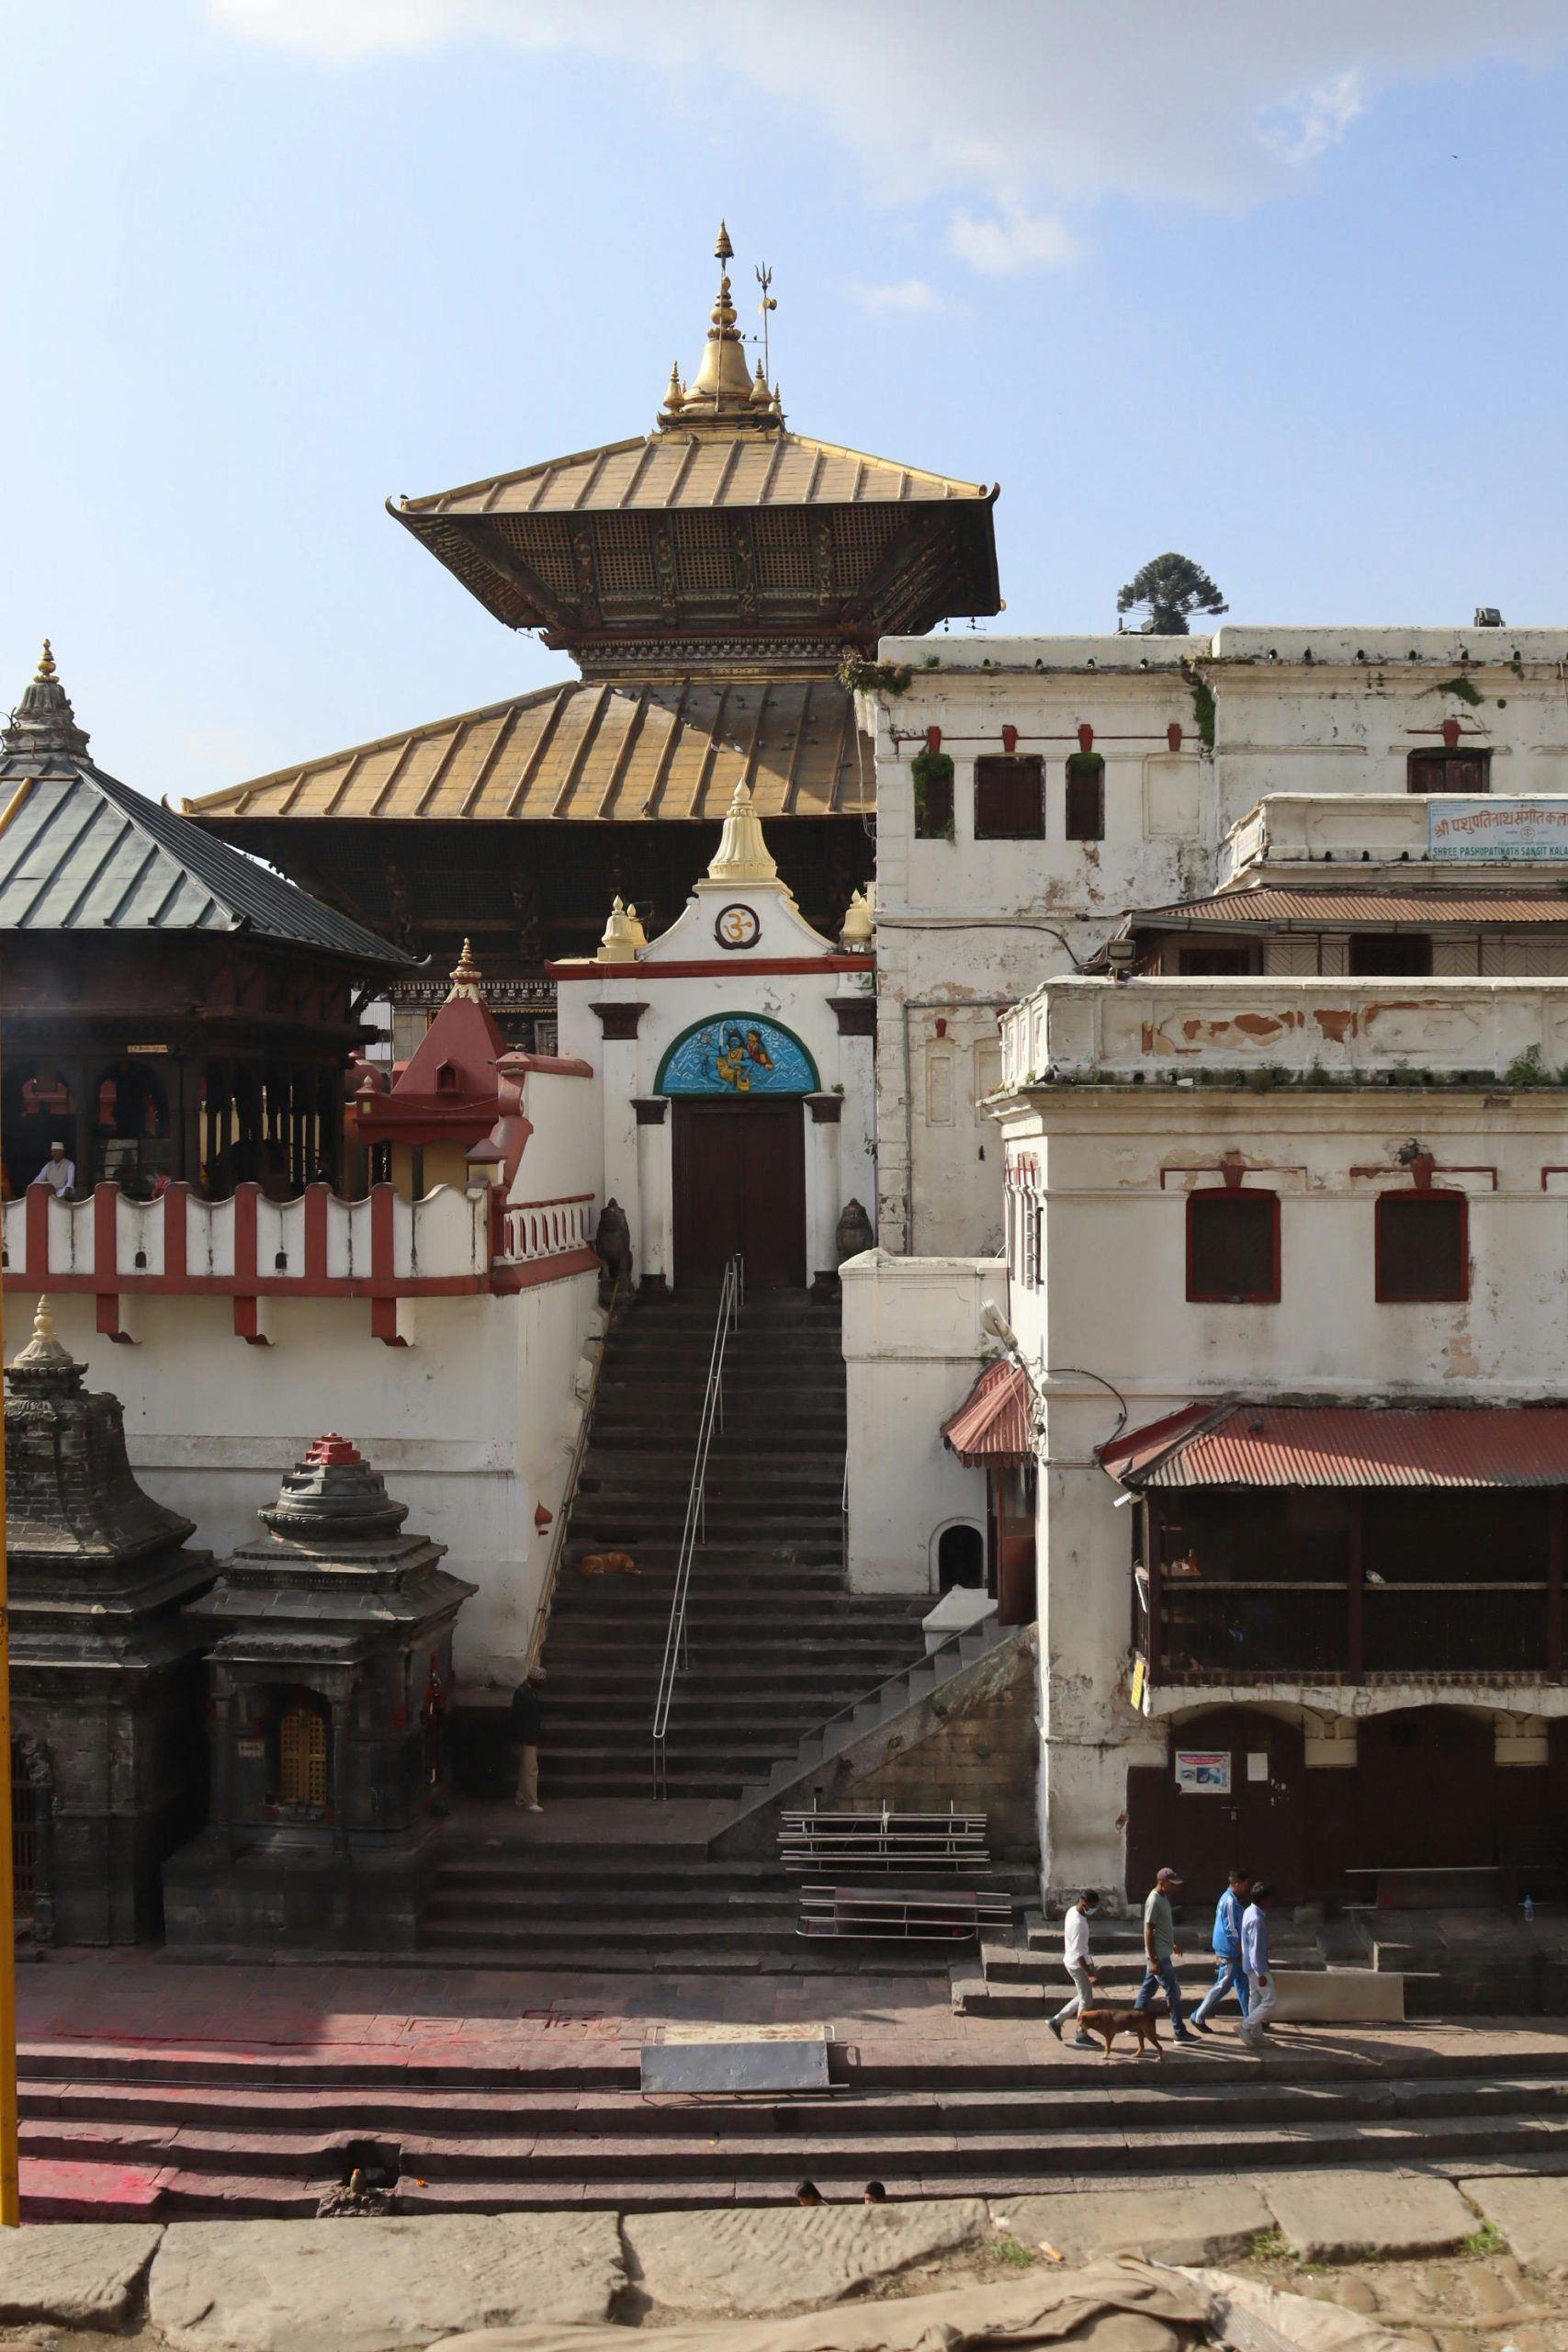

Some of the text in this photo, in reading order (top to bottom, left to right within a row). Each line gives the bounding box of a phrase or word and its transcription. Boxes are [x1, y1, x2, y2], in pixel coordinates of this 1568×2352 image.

[1434, 820, 1449, 838] श्री
[1450, 809, 1514, 834] पशुपतिनाथ
[1433, 846, 1568, 856] SHREE PASHUPATINATH SANGIT KALA
